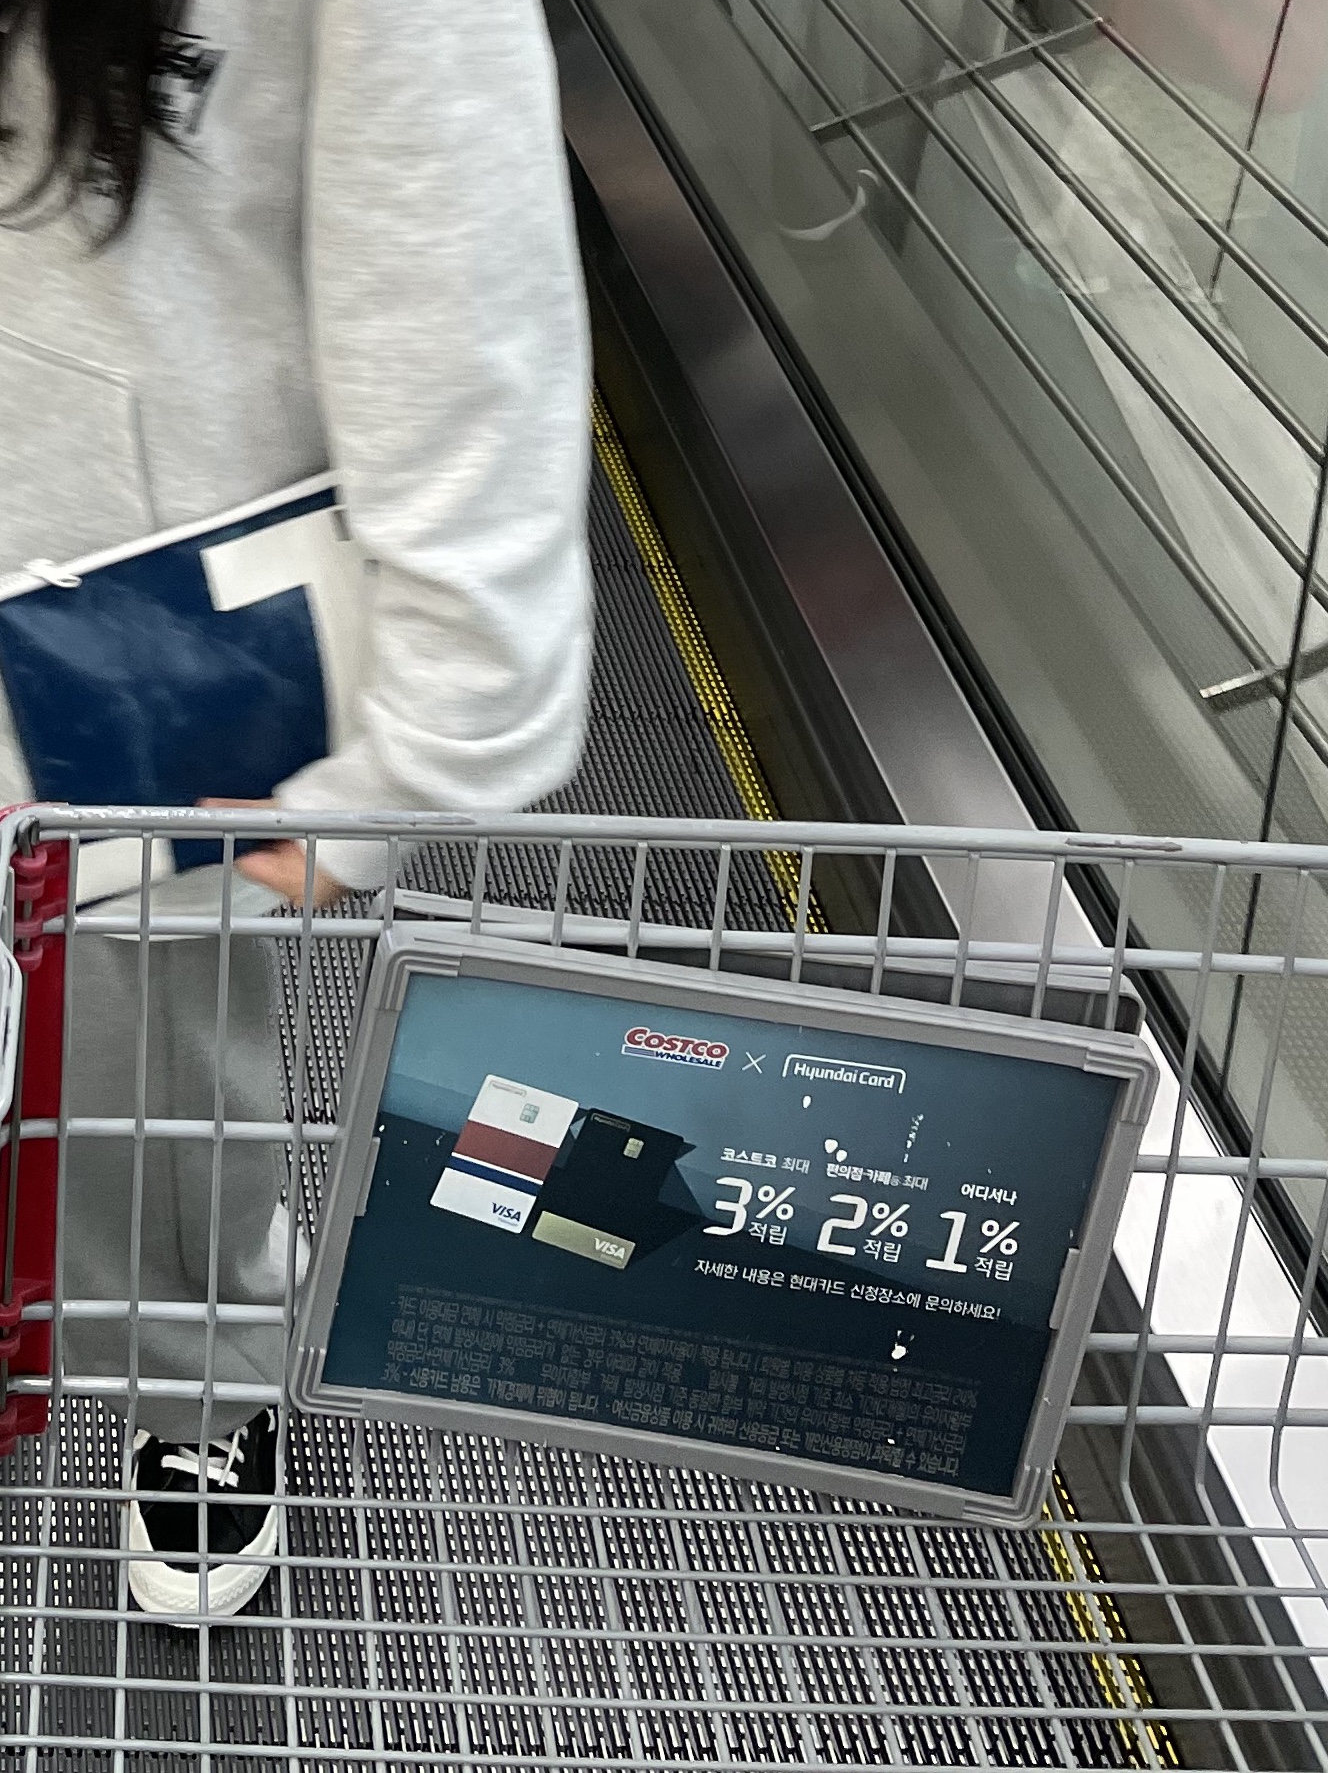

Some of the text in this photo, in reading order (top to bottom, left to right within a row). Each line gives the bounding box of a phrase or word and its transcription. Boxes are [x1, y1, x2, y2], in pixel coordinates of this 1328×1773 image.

[625, 1027, 728, 1059] COSTCO
[655, 1050, 722, 1068] WHOLESALE
[794, 1062, 895, 1090] Hyundai Card
[720, 1147, 811, 1175] 코스트코 최대
[703, 1176, 797, 1236] 3%
[961, 1182, 1018, 1206] 어디서나
[491, 1201, 522, 1223] VISA
[816, 1193, 911, 1256] 2%
[747, 1221, 789, 1246] 적립
[925, 1210, 1021, 1274] 1%
[594, 1237, 626, 1260] VISA
[862, 1237, 903, 1263] 적립
[973, 1256, 1015, 1282] 적립
[694, 1259, 1002, 1321] 자세한 내용은 현대카드 신청장소에 문의하세요!
